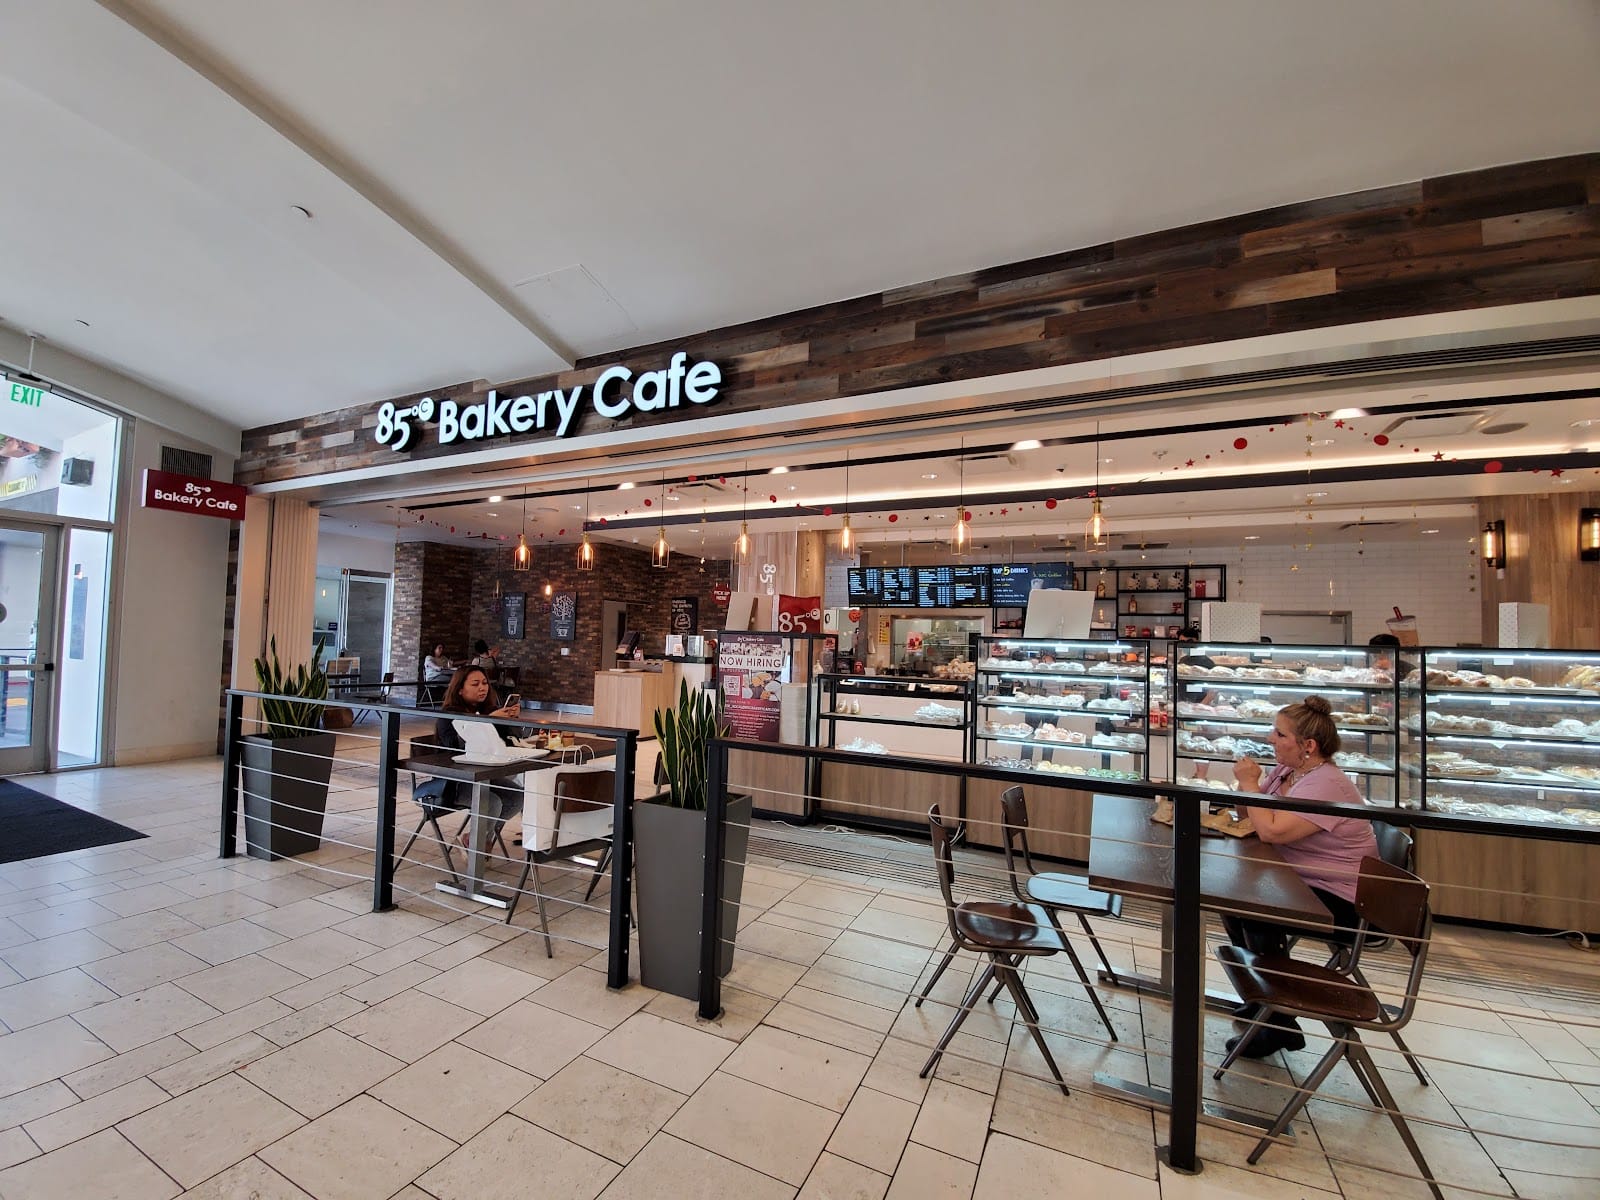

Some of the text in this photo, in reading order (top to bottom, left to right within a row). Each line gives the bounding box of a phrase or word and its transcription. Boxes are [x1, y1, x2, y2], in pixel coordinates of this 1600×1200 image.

[10, 383, 44, 407] EXIT
[438, 385, 583, 444] Bakery
[592, 352, 722, 418] Cafe
[154, 489, 238, 511] Bakery Cafe
[1003, 566, 1011, 576] 5
[720, 656, 781, 668] NOW HIRING
